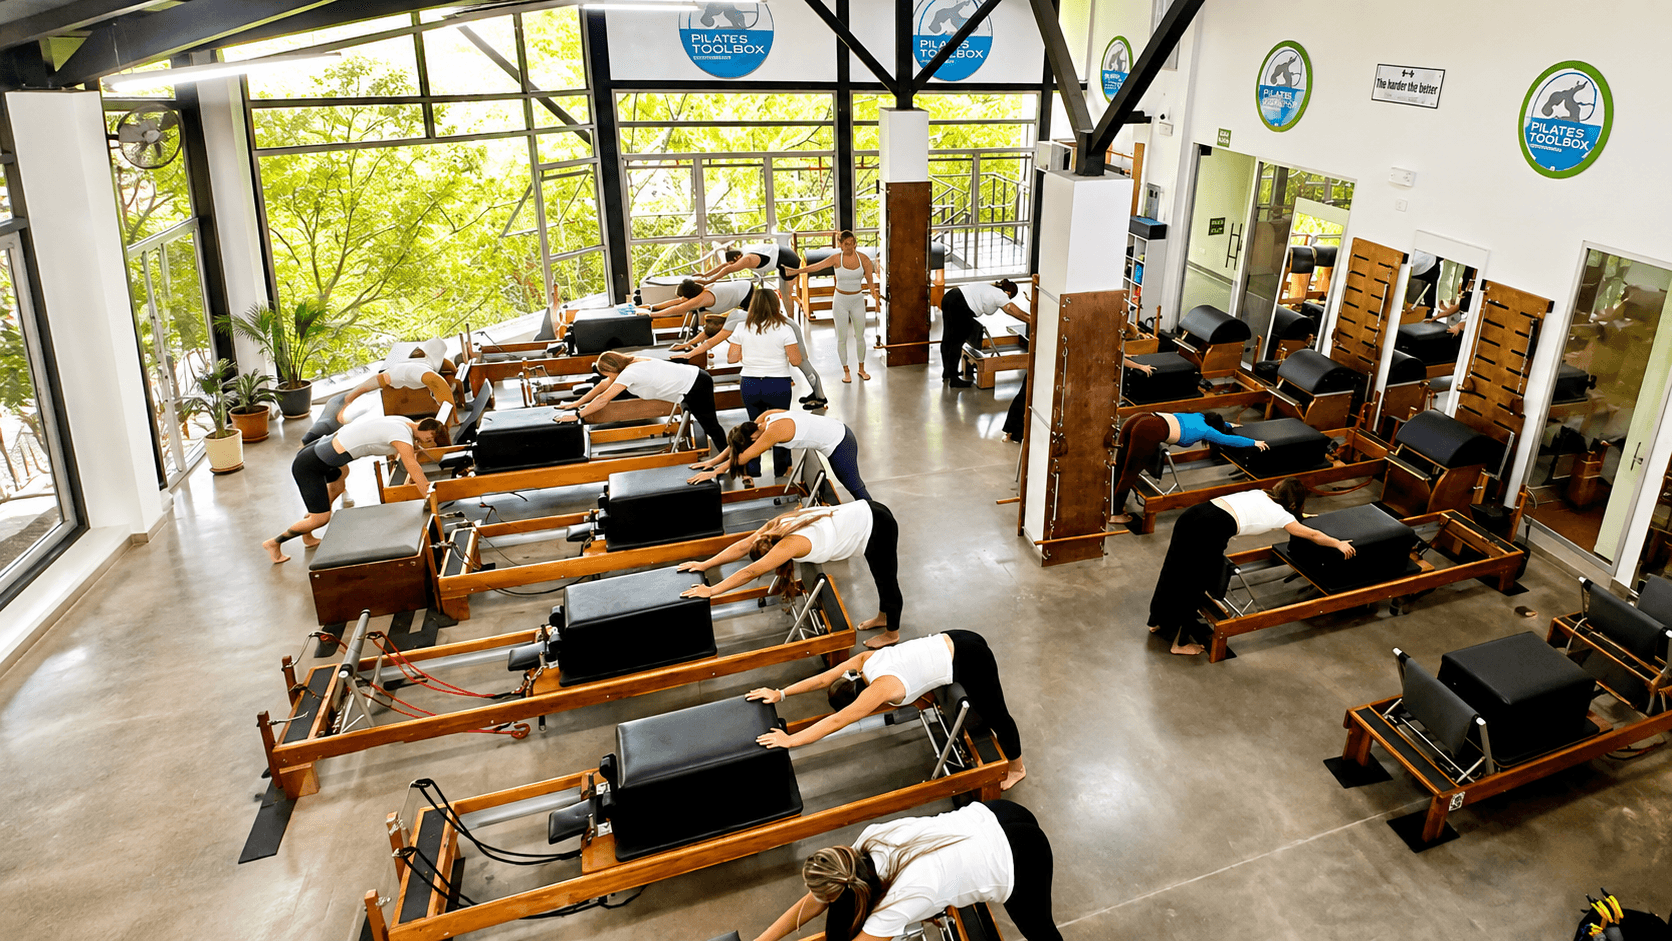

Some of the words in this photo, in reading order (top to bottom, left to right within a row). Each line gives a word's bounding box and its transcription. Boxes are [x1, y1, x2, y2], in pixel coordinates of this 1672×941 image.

[691, 34, 748, 44] PILATES
[920, 39, 970, 49] PILAS
[692, 44, 765, 55] TOOLBOX
[1376, 77, 1387, 89] The
[1387, 78, 1408, 91] harder
[1407, 81, 1419, 93] the
[1418, 82, 1438, 95] better
[1531, 122, 1584, 138] PILATES
[1530, 133, 1589, 151] TOOLBOX
